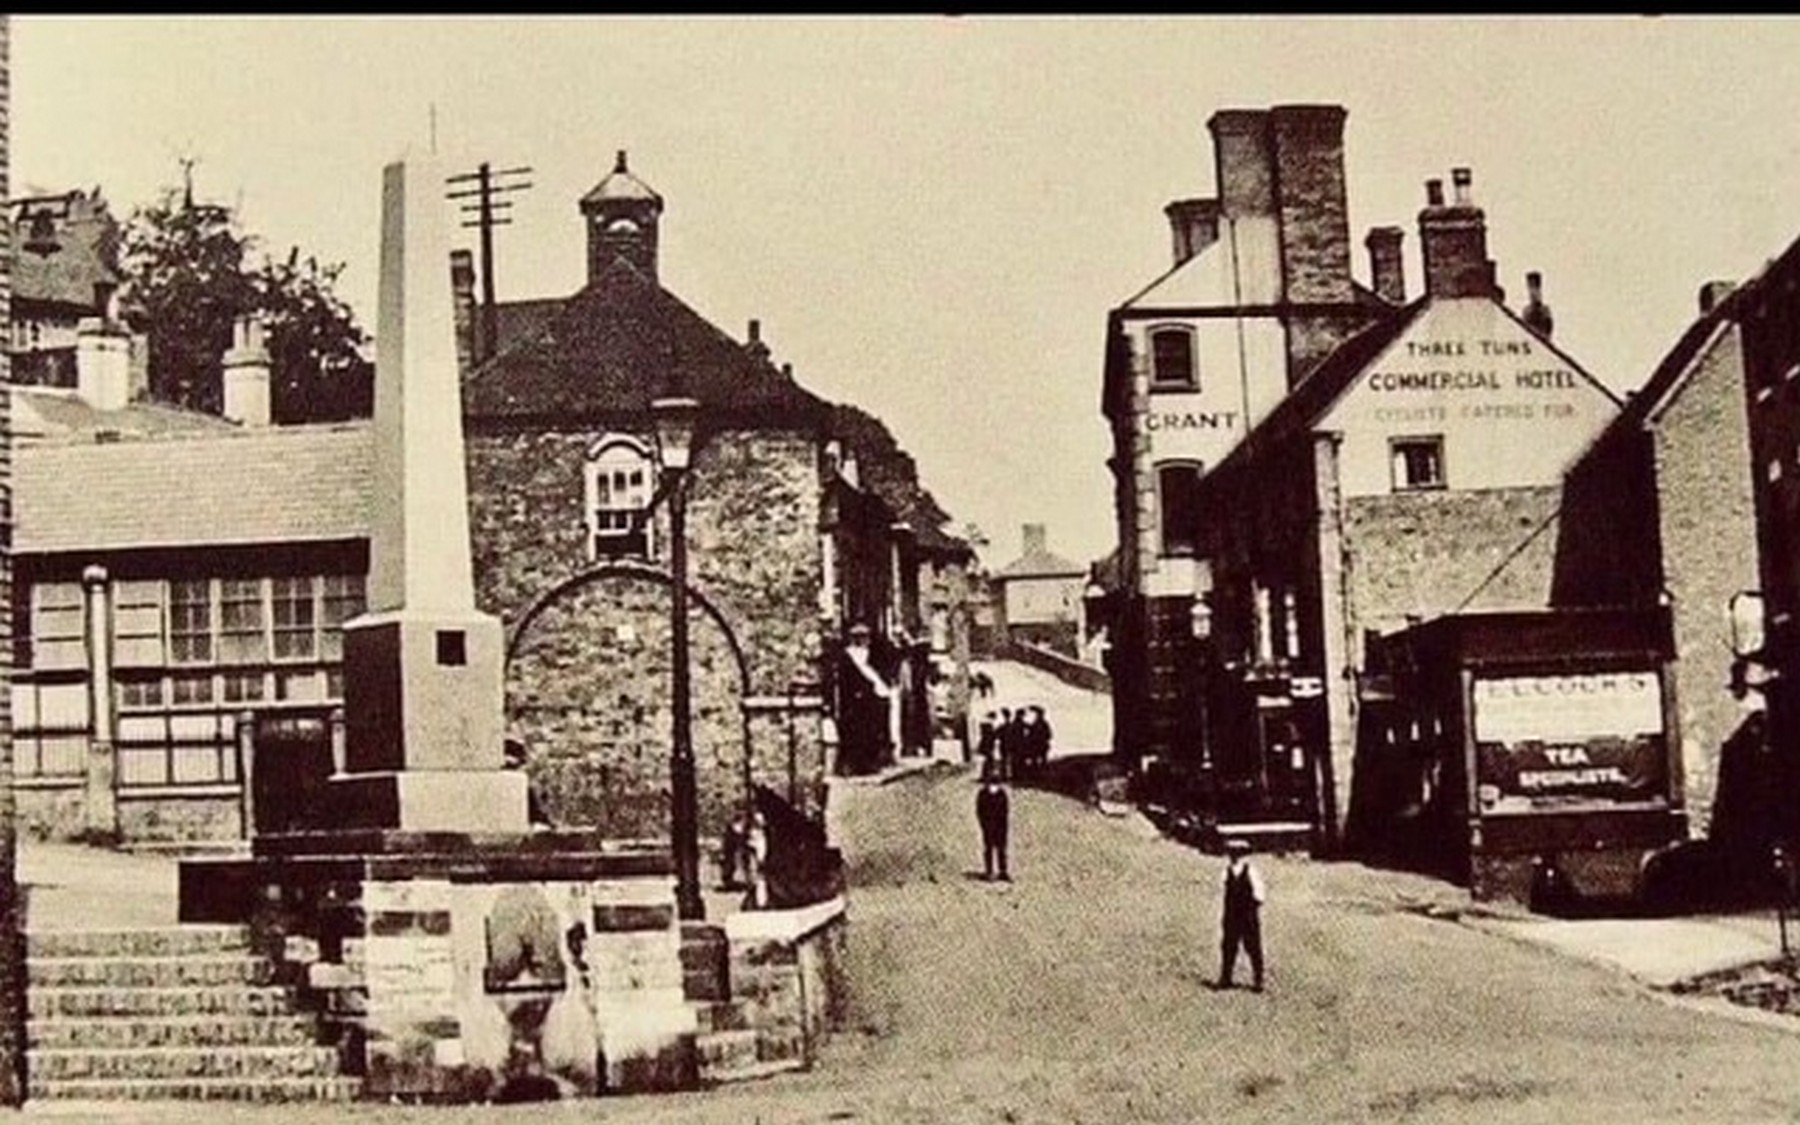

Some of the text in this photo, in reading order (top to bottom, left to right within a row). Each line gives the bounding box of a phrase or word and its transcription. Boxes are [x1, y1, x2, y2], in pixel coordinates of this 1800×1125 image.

[1407, 341, 1532, 356] THREE TUNS
[1369, 370, 1576, 391] COMMERCIAL HOTEL
[1145, 412, 1238, 431] GRANT
[1544, 747, 1592, 765] TEA
